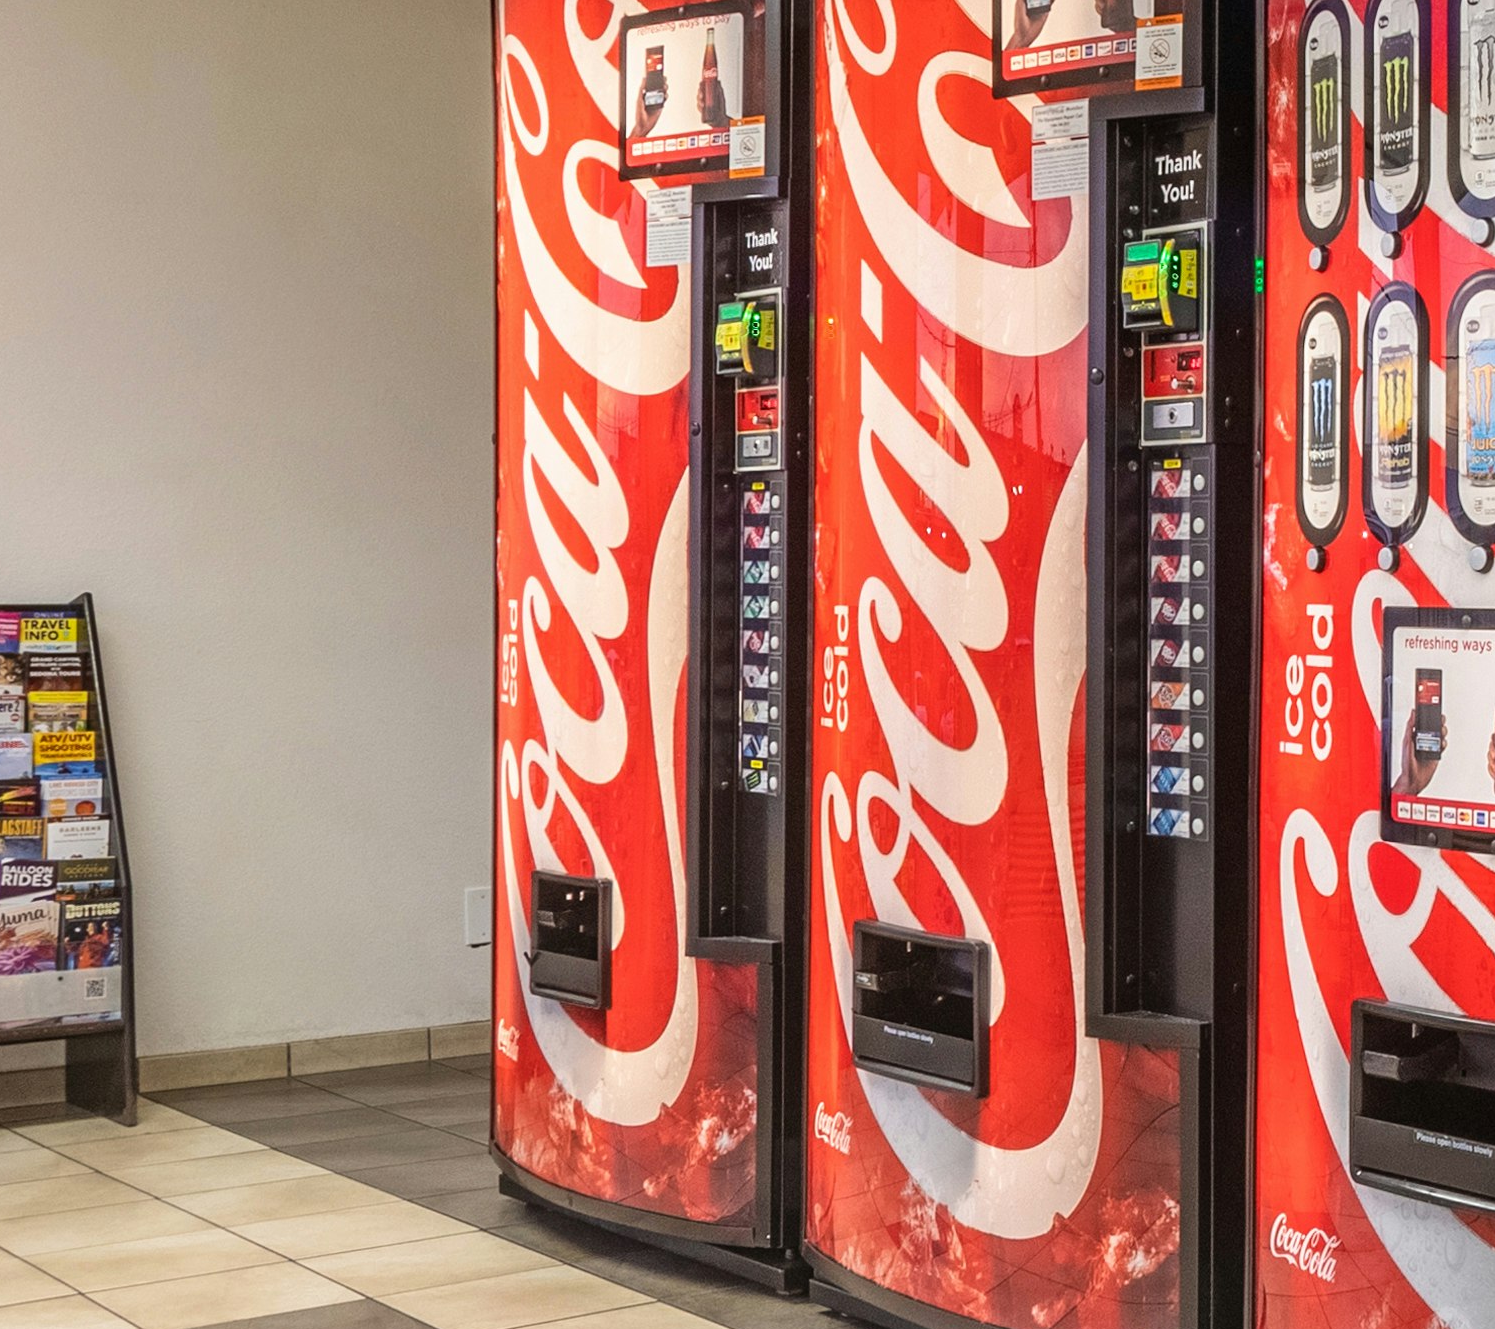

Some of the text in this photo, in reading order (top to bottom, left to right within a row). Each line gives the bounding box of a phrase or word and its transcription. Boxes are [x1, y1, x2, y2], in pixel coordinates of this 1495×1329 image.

[679, 17, 700, 29] ways
[702, 16, 712, 25] to
[714, 14, 731, 25] pay
[1155, 149, 1202, 177] Thank
[1160, 180, 1195, 204] You!
[745, 228, 778, 248] Thank
[749, 253, 773, 272] You!
[24, 619, 71, 631] TRAVEL
[24, 630, 59, 642] INFO
[508, 598, 519, 708] cold
[1405, 635, 1459, 654] refreshing
[1462, 639, 1492, 653] ways
[500, 633, 510, 705] ice
[834, 603, 849, 734] cold
[819, 646, 834, 729] ice
[1308, 603, 1333, 762] cold
[14, 700, 21, 712] 2
[1280, 653, 1304, 757] ice
[39, 744, 93, 752] SHOOTING
[40, 734, 92, 744] ATV/UTV
[1, 874, 54, 888] RIDES
[2, 865, 54, 875] BALLOON
[815, 1101, 853, 1156] Coca-Cola
[1416, 1131, 1494, 1159] Please open bottles slowly
[1269, 1211, 1337, 1284] Coca-Cola
